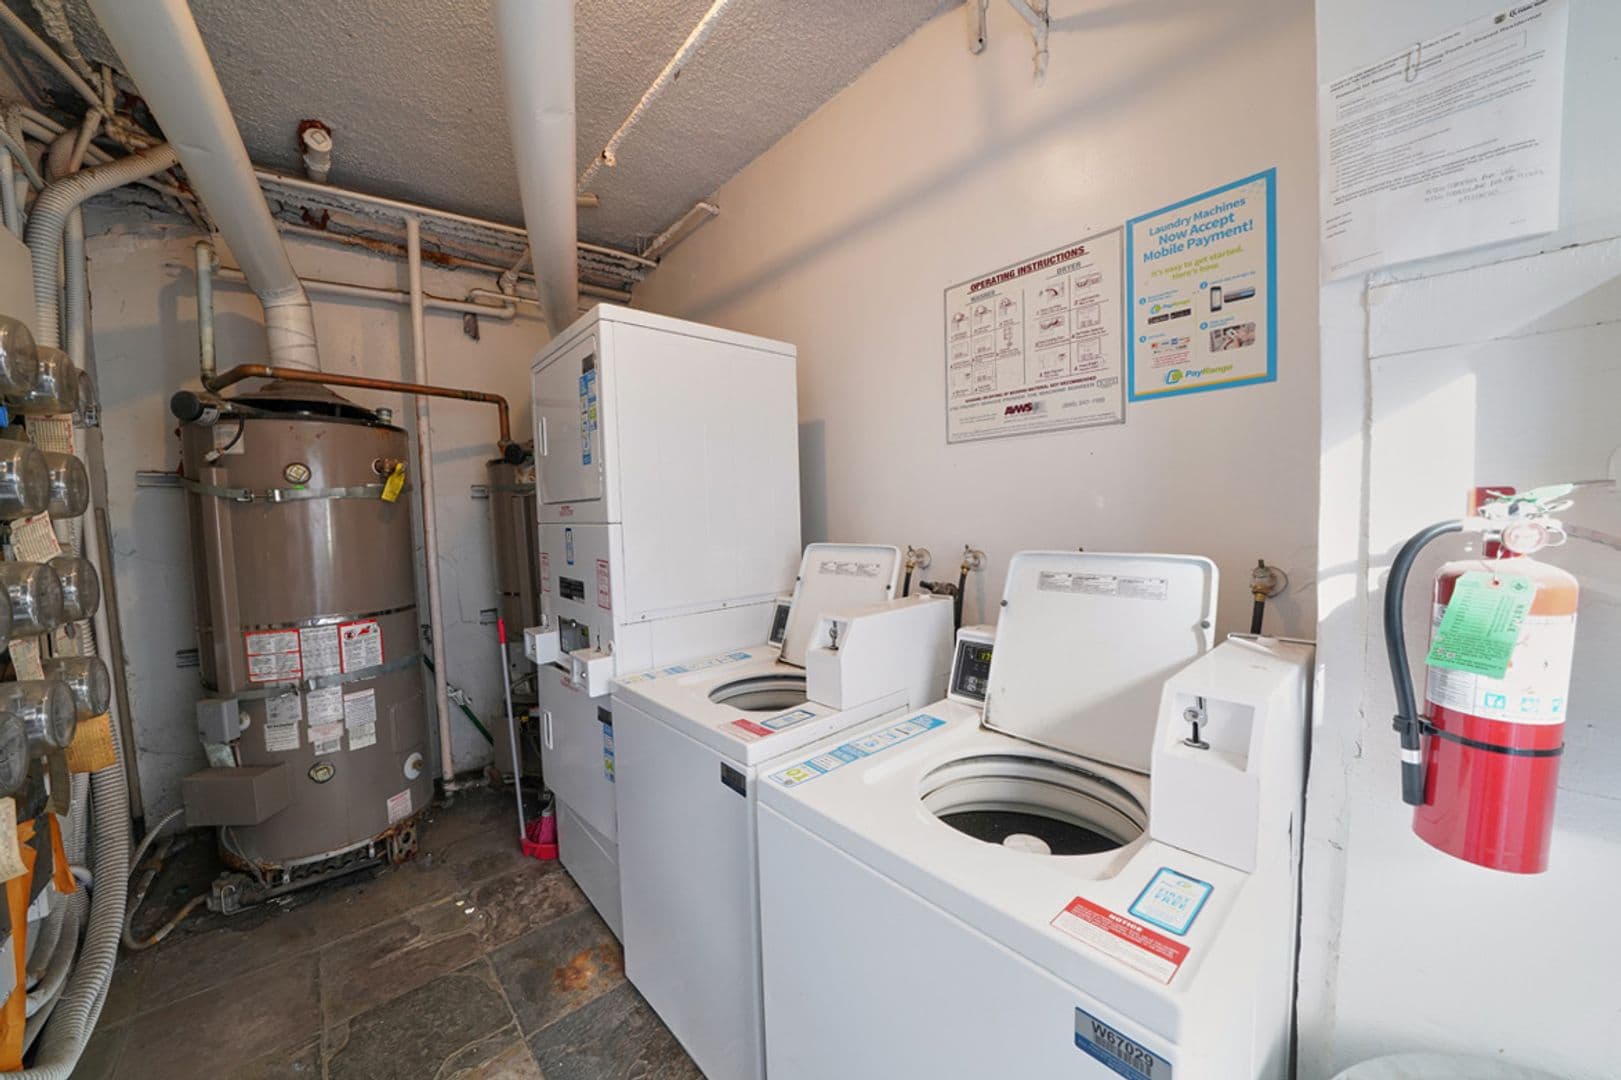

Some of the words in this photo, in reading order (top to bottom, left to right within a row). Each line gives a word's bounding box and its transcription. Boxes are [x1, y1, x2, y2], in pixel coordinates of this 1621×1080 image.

[1149, 216, 1192, 237] Laundry
[1193, 198, 1246, 220] Machines
[1158, 228, 1188, 245] Now
[1190, 212, 1235, 235] Accept
[1143, 242, 1185, 263] Mobile
[1186, 218, 1254, 249] Payment!
[970, 269, 1015, 292] OPERATING
[1017, 245, 1085, 276] INSTRUCTIONS
[1056, 261, 1082, 275] DRYER
[1091, 1020, 1154, 1069] W67029
